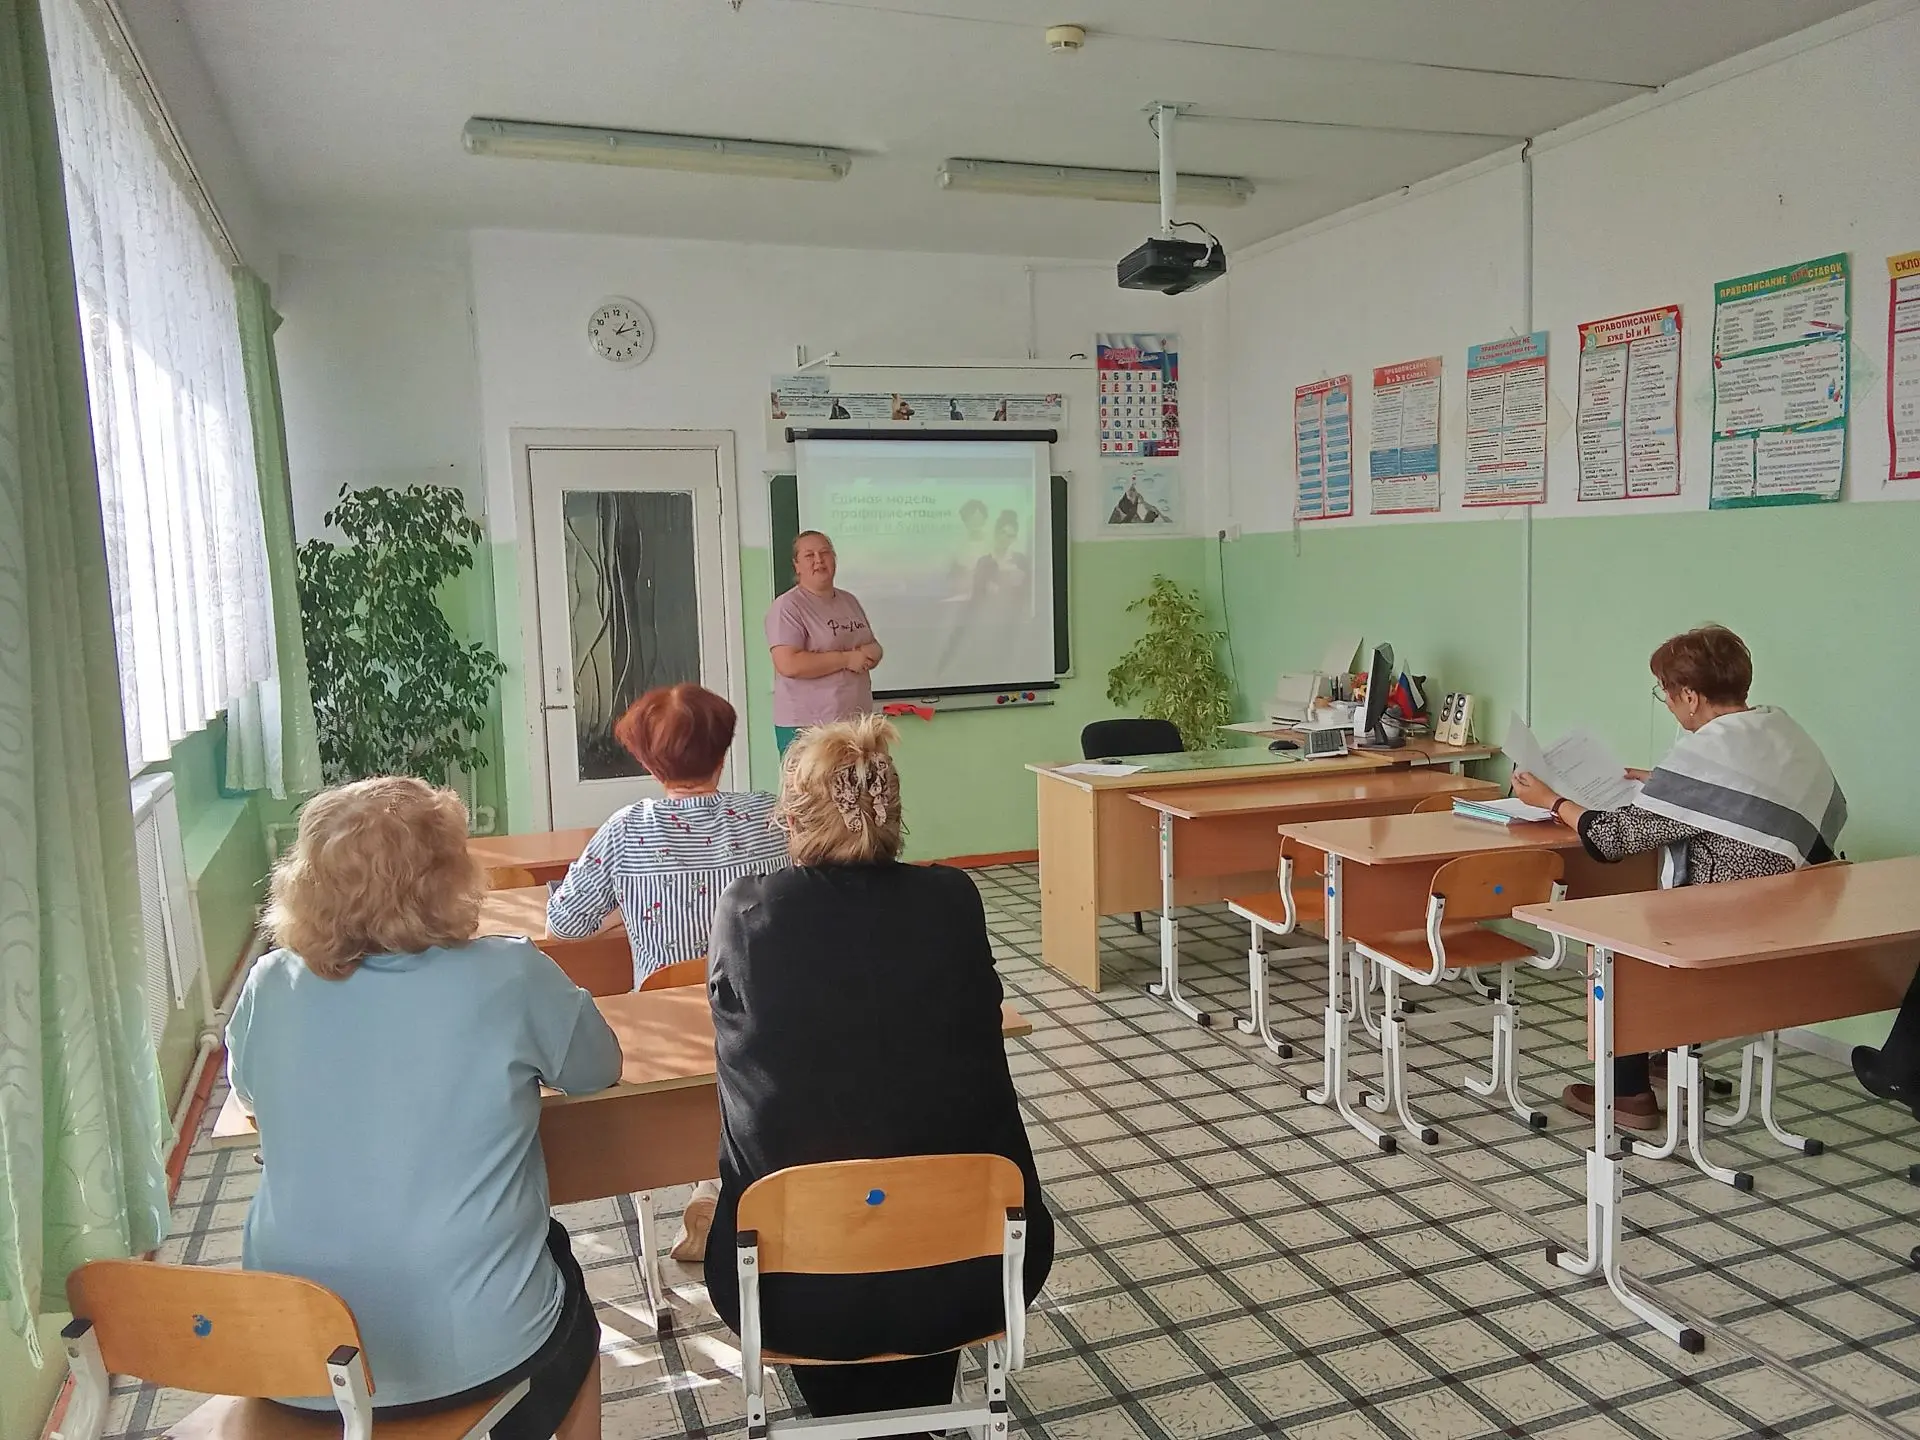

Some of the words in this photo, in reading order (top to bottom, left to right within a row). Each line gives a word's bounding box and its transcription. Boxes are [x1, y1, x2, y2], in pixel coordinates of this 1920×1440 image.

[1895, 257, 1920, 271] СКЛО
[1720, 275, 1787, 297] ПРАВОПИСАНИЕ
[596, 318, 605, 326] 10
[1594, 313, 1663, 333] ПРАВОПИСАНИЕ
[1607, 335, 1624, 343] БУКВ
[1625, 329, 1635, 339] Ы
[1101, 372, 1107, 381] А
[1114, 372, 1119, 381] Б
[1126, 372, 1132, 381] В
[1138, 372, 1144, 381] Г
[1151, 372, 1157, 381] Д
[1101, 384, 1107, 393] Е
[1139, 384, 1144, 393] З
[1114, 396, 1120, 404] К
[1126, 396, 1132, 404] Л
[1139, 396, 1146, 404] М
[1151, 396, 1157, 404] Н
[1101, 408, 1107, 416] О
[1114, 408, 1119, 416] П
[1126, 408, 1132, 416] Р
[1139, 408, 1144, 416] С
[1151, 408, 1157, 416] Т
[1101, 420, 1107, 428] У
[1114, 420, 1121, 428] Ф
[1127, 420, 1132, 428] Х
[1139, 420, 1145, 428] Ц
[1151, 420, 1157, 428] Ч
[1102, 431, 1110, 440] Ш
[1114, 431, 1123, 440] Щ
[1128, 431, 1134, 440] Ъ
[1139, 431, 1148, 440] Ы
[1151, 431, 1157, 440] Ь
[1102, 443, 1107, 451] Э
[1127, 443, 1133, 451] Я
[831, 492, 881, 504] Единая
[887, 494, 936, 505] модель
